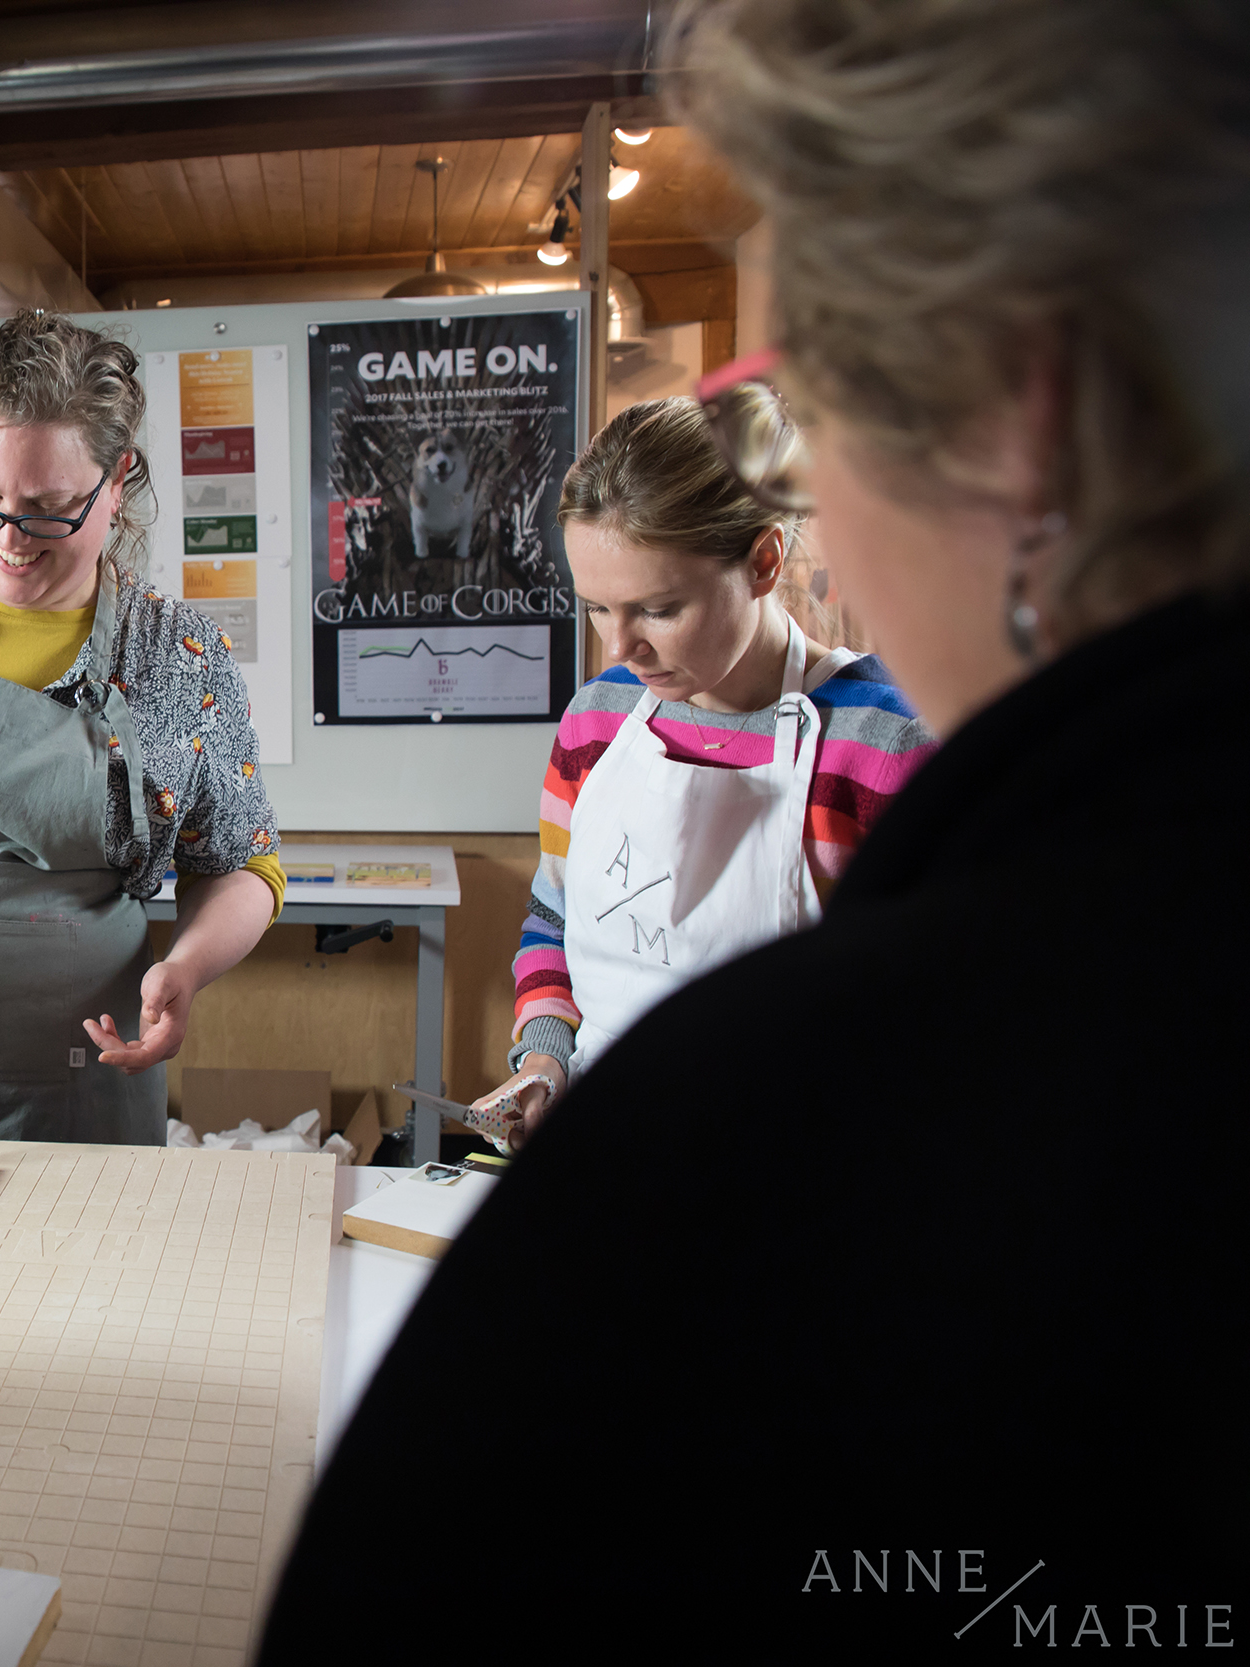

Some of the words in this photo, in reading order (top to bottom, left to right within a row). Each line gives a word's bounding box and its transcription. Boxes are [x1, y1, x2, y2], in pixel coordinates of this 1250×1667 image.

[330, 343, 351, 353] 25%
[357, 347, 477, 382] GAME
[486, 344, 558, 375] ON.
[365, 393, 387, 404] 2017
[390, 391, 413, 402] FALL
[415, 389, 445, 401] SALES
[446, 389, 454, 400] &
[455, 387, 518, 399] MARKETING
[520, 385, 549, 396] BLITZ
[352, 413, 376, 423] We're
[377, 412, 408, 423] chasing
[434, 409, 442, 418] of
[444, 409, 461, 419] 20%
[463, 408, 497, 418] increase
[498, 407, 506, 416] in
[507, 407, 527, 416] sales
[528, 407, 546, 415] over
[446, 421, 457, 429] we
[459, 420, 474, 428] can
[475, 419, 488, 429] get
[489, 418, 514, 427] there!
[605, 832, 630, 889] A
[628, 913, 671, 966] M
